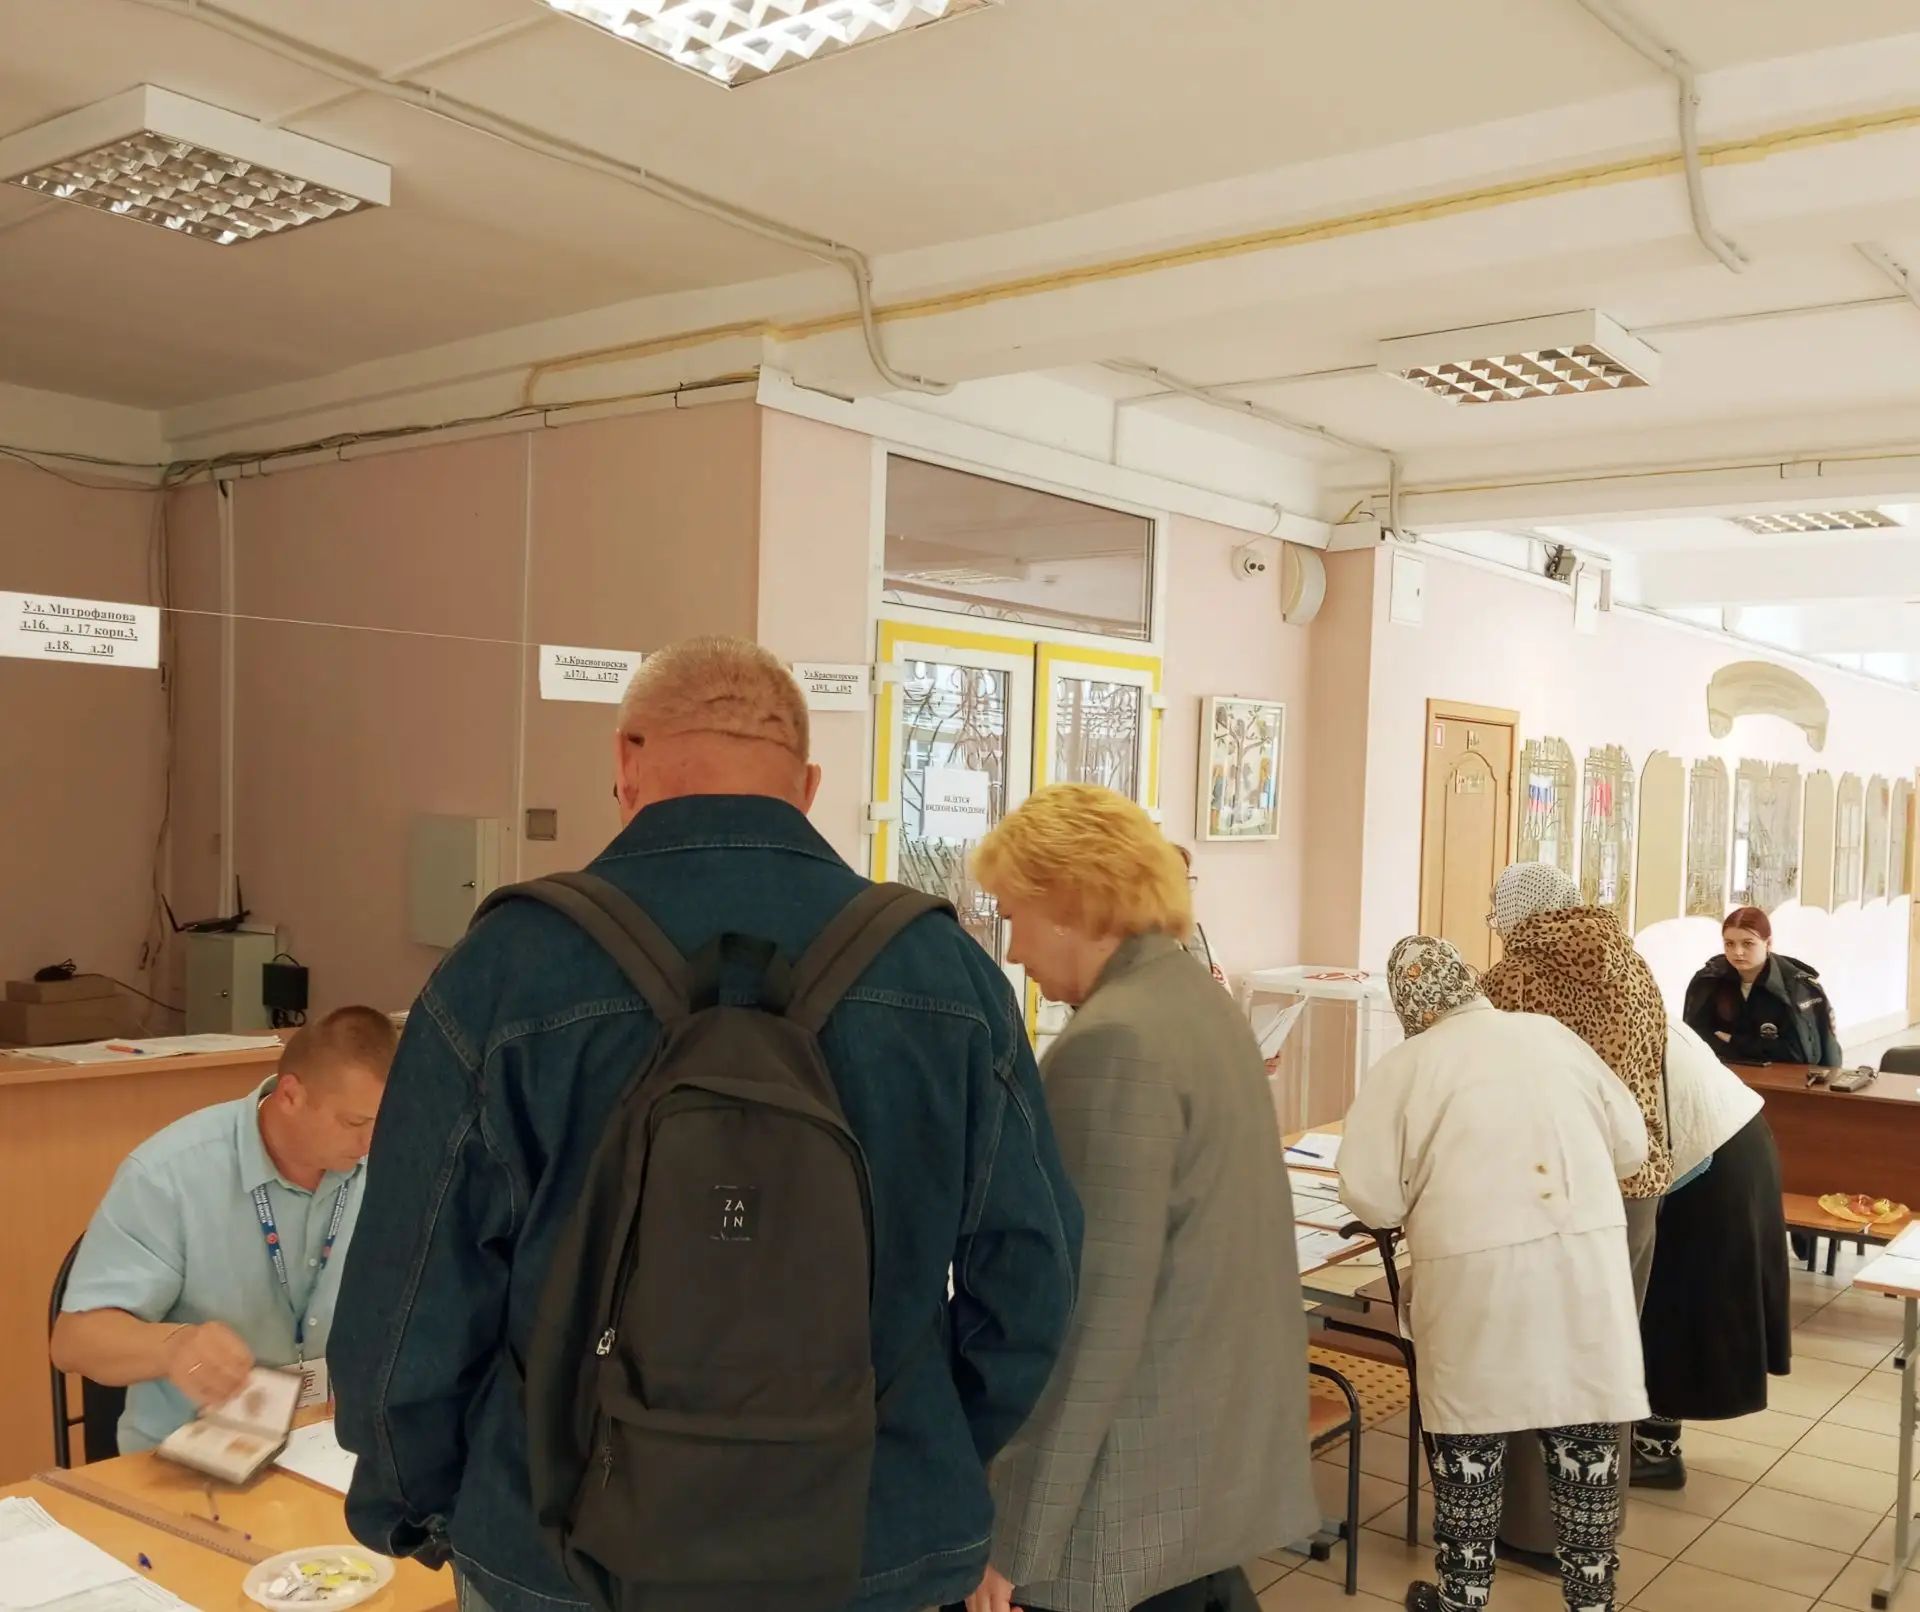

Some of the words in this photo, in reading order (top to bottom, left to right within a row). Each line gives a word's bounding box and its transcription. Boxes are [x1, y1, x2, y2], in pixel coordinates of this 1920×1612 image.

[23, 600, 45, 612] Ул.
[49, 603, 136, 622] Митрофанова
[78, 623, 91, 634] 17
[89, 643, 114, 655] д.20
[724, 1199, 745, 1212] ZA
[723, 1215, 744, 1228] IN
